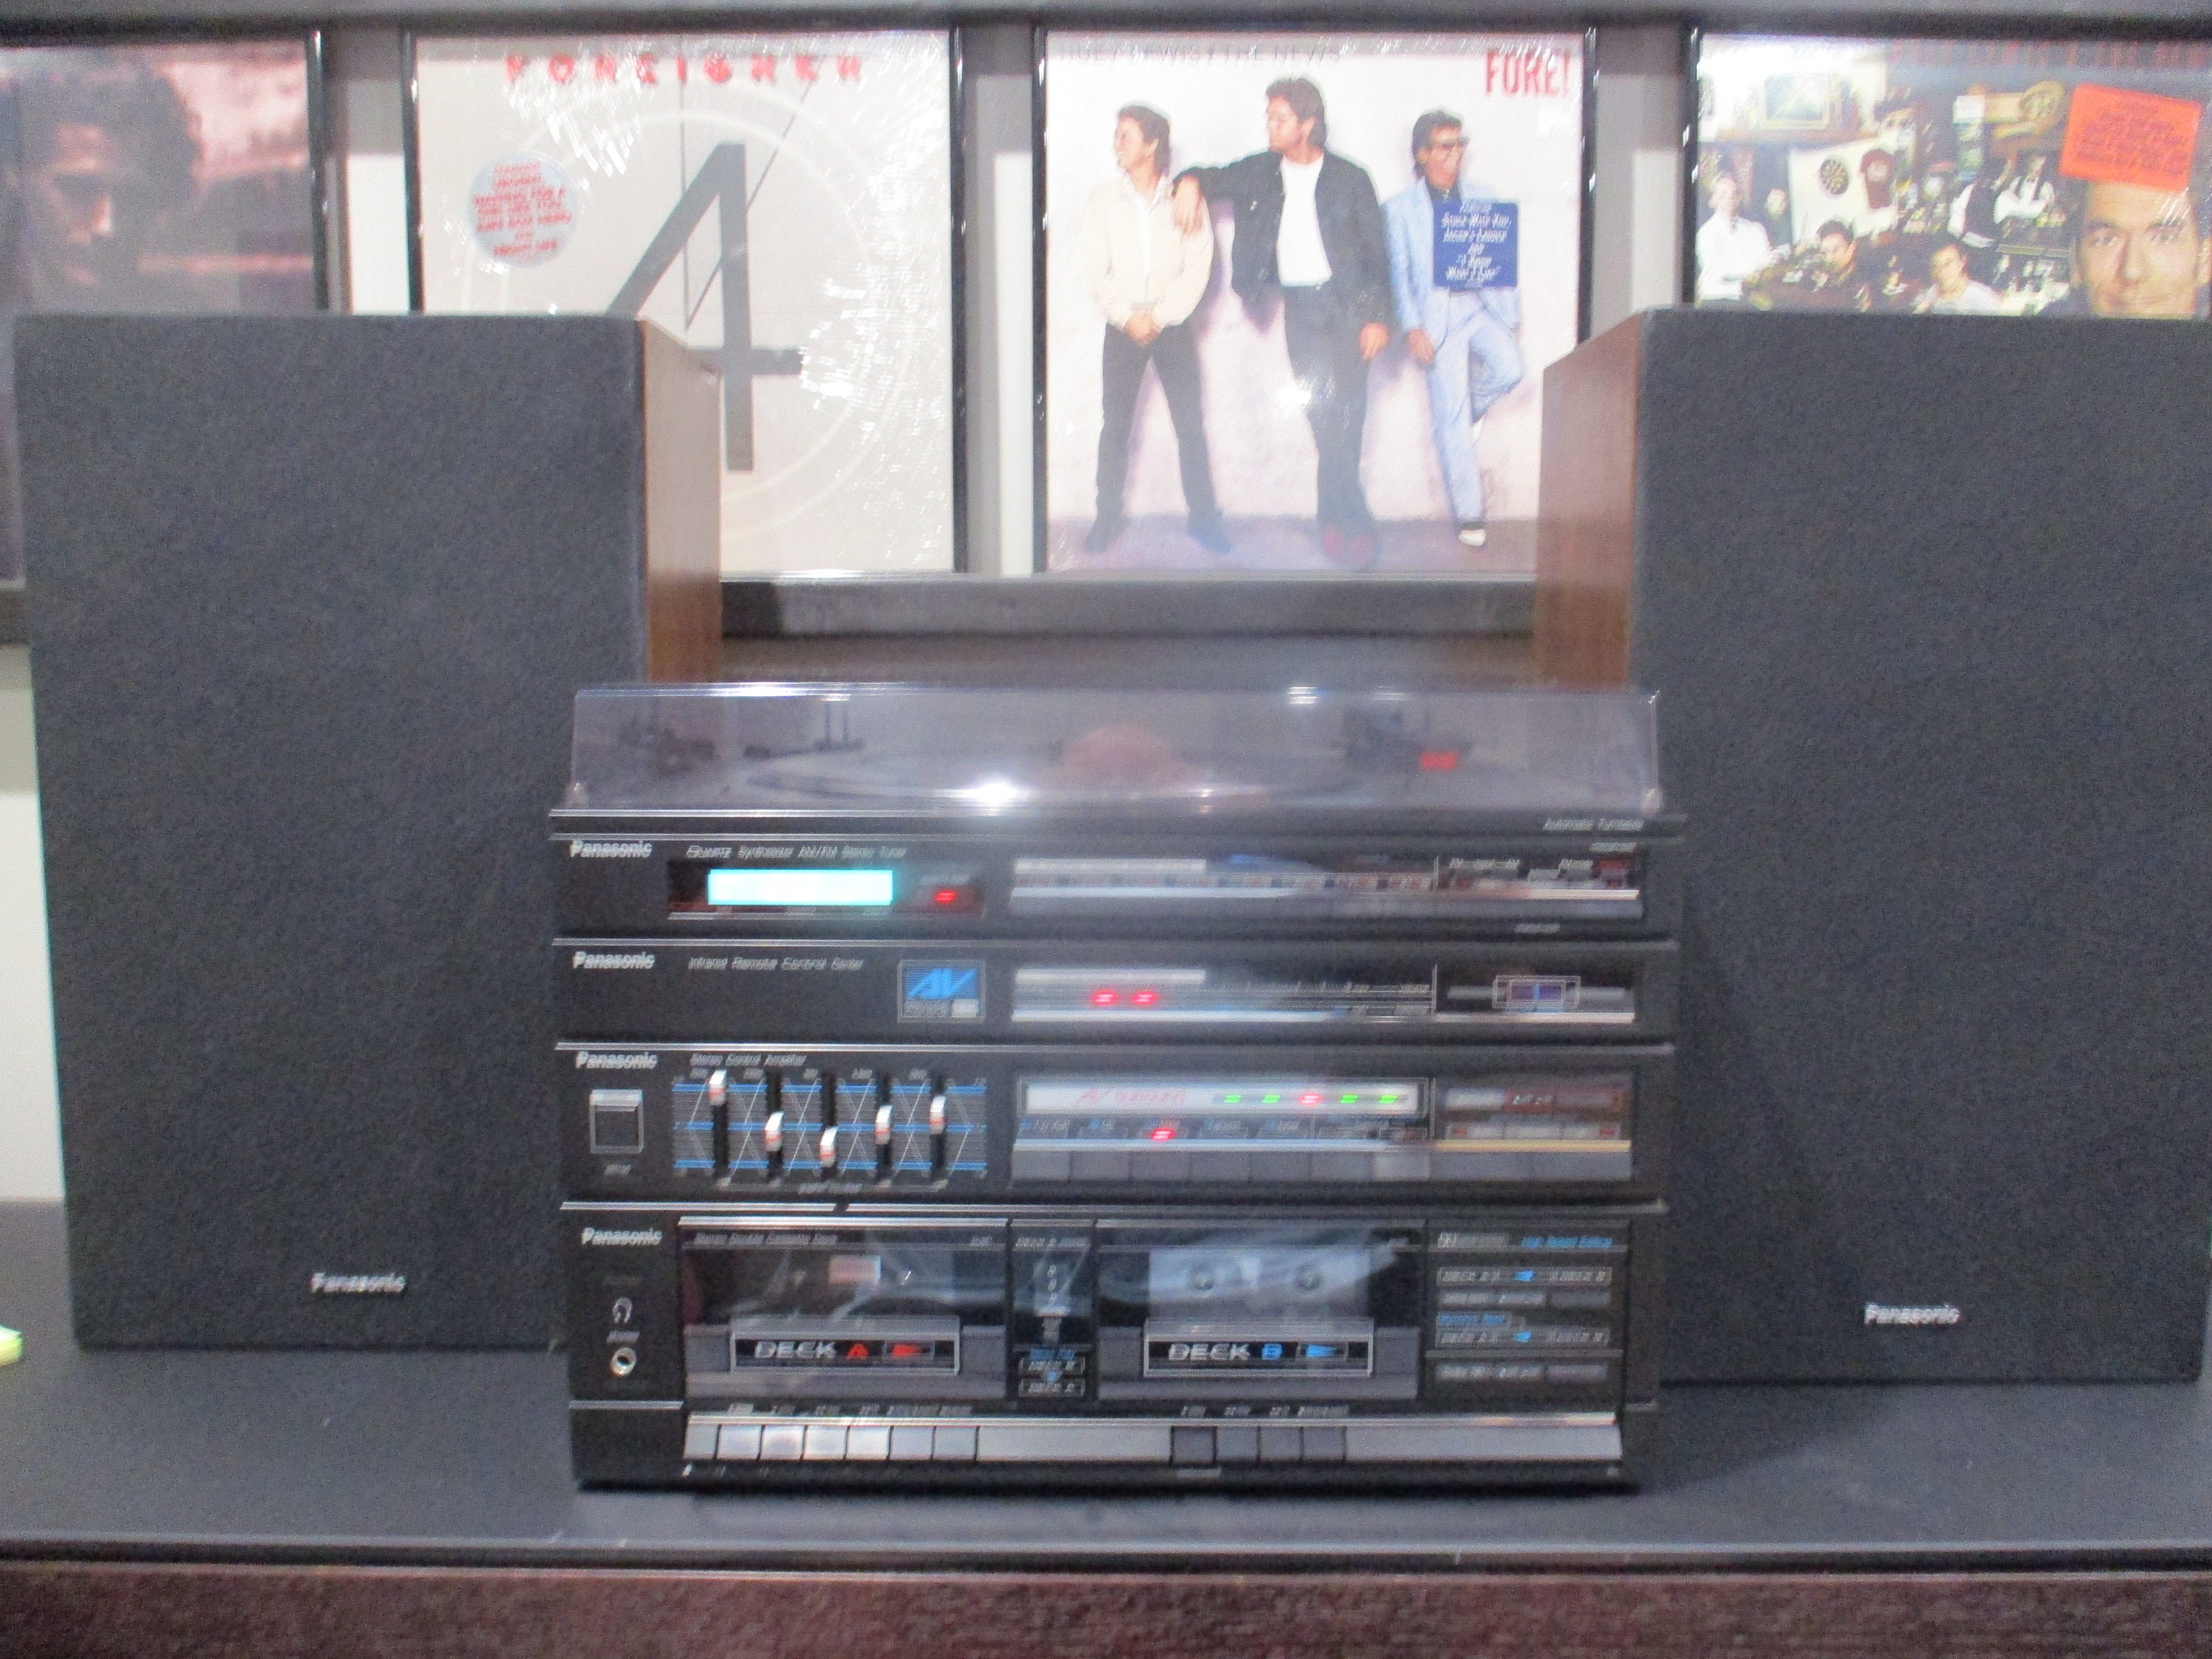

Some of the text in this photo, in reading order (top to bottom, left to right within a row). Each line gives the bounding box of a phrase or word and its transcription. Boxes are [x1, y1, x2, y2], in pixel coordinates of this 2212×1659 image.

[570, 840, 653, 858] Panasonic
[573, 951, 655, 969] Panasonic
[576, 1051, 658, 1069] Panasonic
[581, 1227, 663, 1246] Panasonic
[310, 1271, 406, 1293] Panasonic
[1864, 1303, 1961, 1324] Panasonic
[754, 1340, 870, 1360] DECK A
[1167, 1343, 1284, 1362] DECK B
